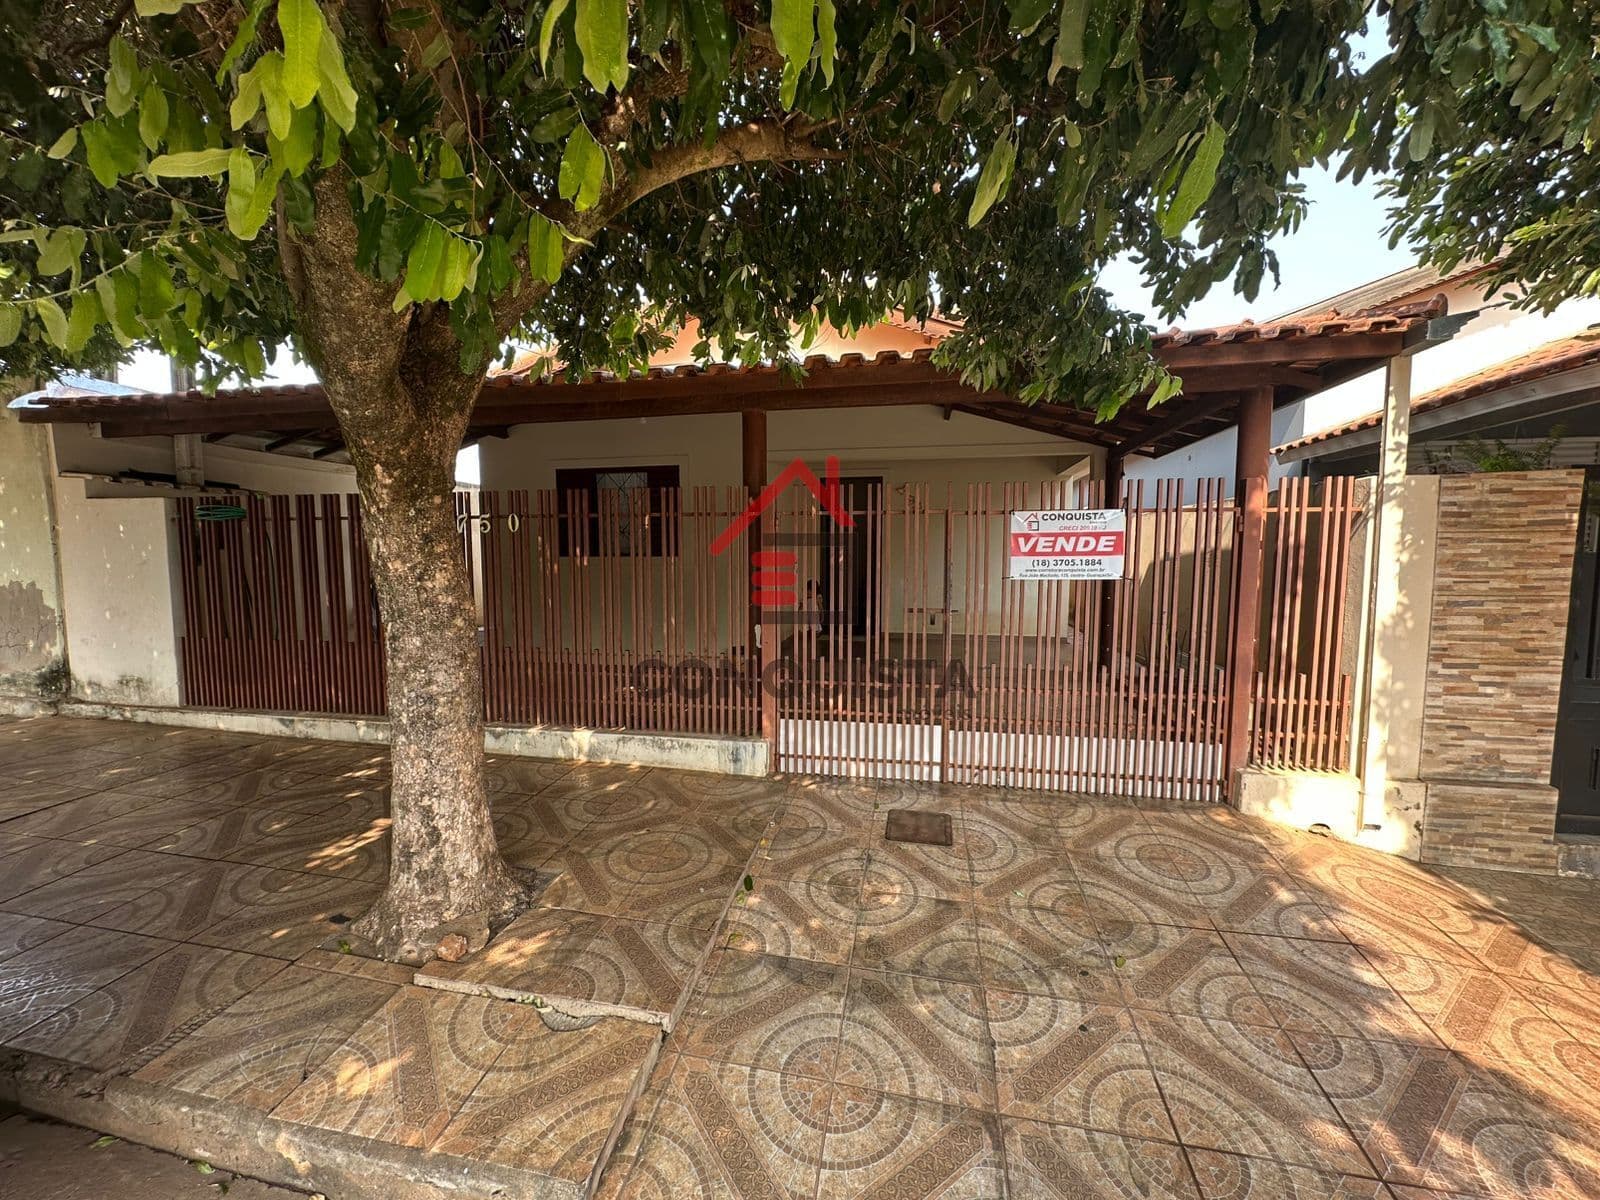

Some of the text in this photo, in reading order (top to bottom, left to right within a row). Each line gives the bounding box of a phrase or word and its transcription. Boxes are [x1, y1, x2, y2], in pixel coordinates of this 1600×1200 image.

[1041, 512, 1106, 521] CONQUISTA
[1017, 535, 1117, 553] VENDE
[1031, 558, 1102, 568] (18) 3705.1884
